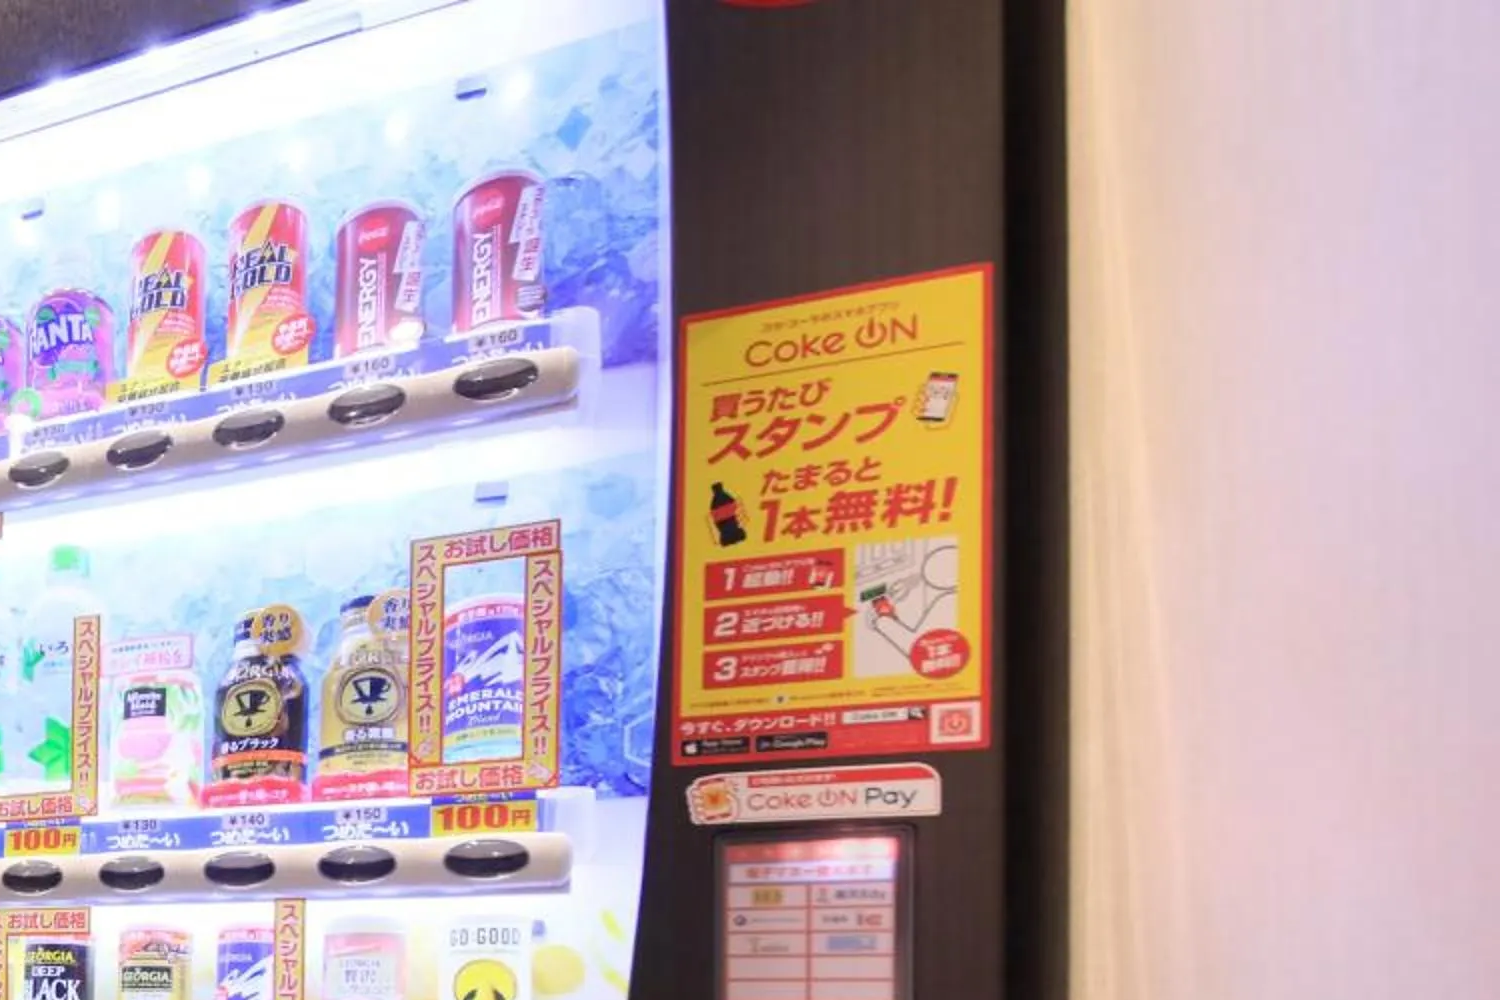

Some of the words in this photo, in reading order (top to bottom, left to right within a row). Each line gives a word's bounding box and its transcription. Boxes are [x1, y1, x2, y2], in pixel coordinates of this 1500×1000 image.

[471, 232, 493, 326] ENERGY
[357, 257, 379, 346] ENERGY
[744, 331, 846, 368] Coke
[854, 314, 919, 350] ON
[708, 377, 833, 424] 買うたび
[706, 395, 908, 466] スタンプ
[759, 457, 884, 496] たまると
[757, 476, 959, 544] 1本無料!
[443, 527, 555, 559] お試し価格
[713, 611, 739, 638] 2
[713, 656, 739, 682] 3
[415, 765, 525, 790] お試し価格
[746, 791, 813, 812] Coke
[817, 788, 858, 808] ON
[863, 786, 918, 809] Pay
[434, 804, 533, 832] 100円
[9, 828, 78, 852] 100円
[8, 911, 86, 931] お試し価格
